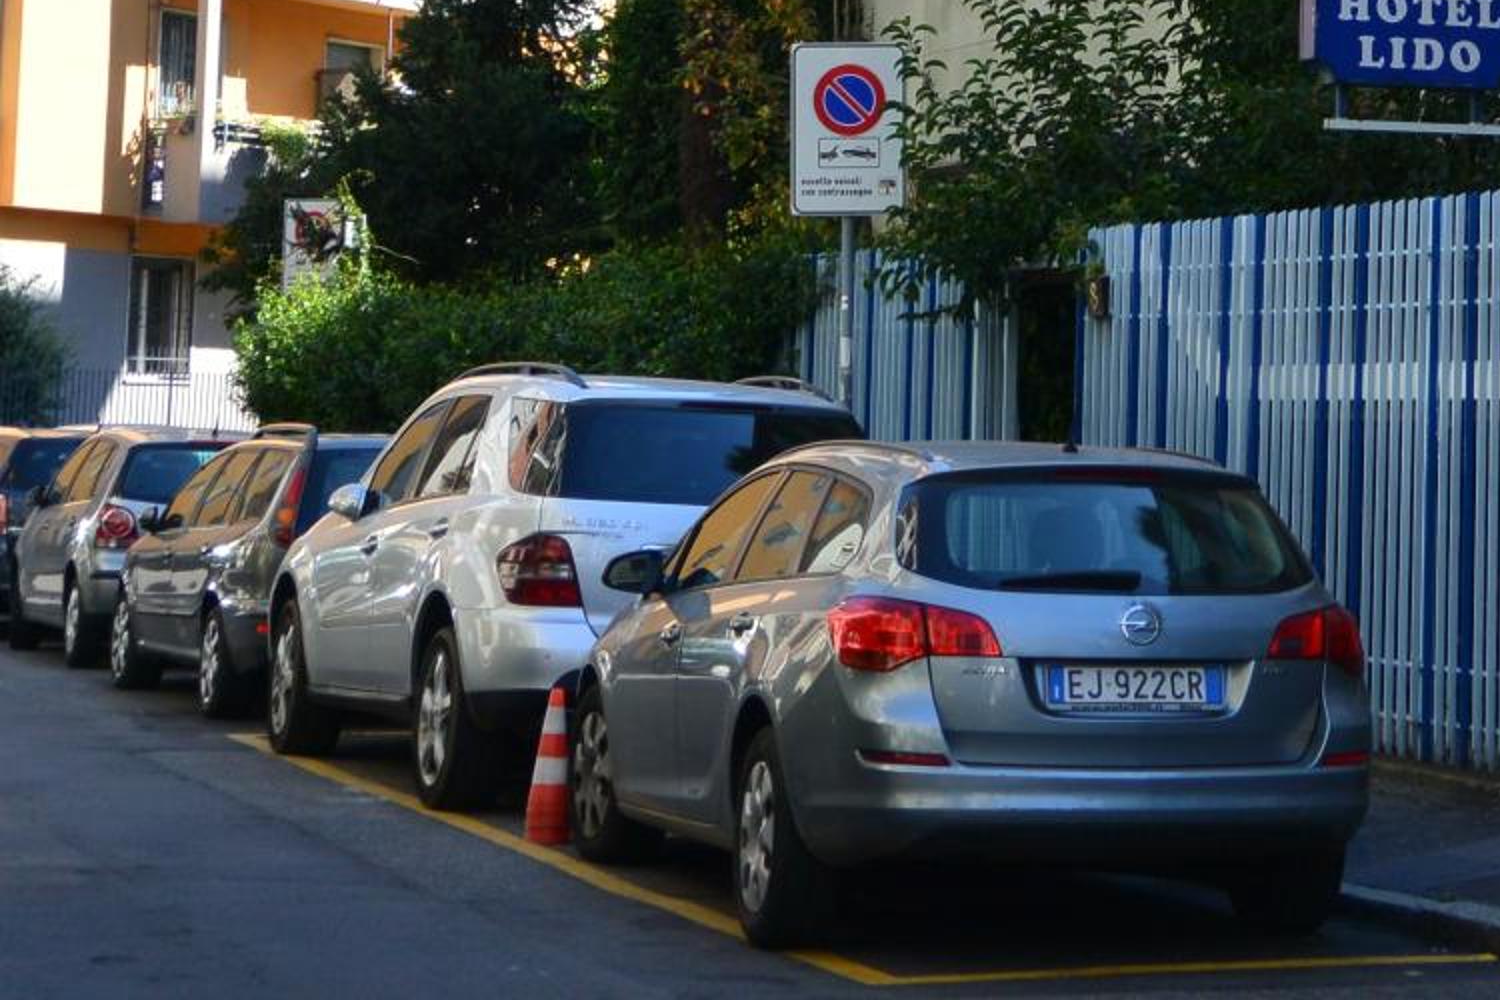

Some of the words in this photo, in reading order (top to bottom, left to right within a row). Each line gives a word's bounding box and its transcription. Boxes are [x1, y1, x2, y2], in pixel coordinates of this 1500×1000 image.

[1358, 35, 1481, 73] LIDO
[1067, 669, 1103, 699] EJ
[1114, 669, 1204, 700] 922CR
